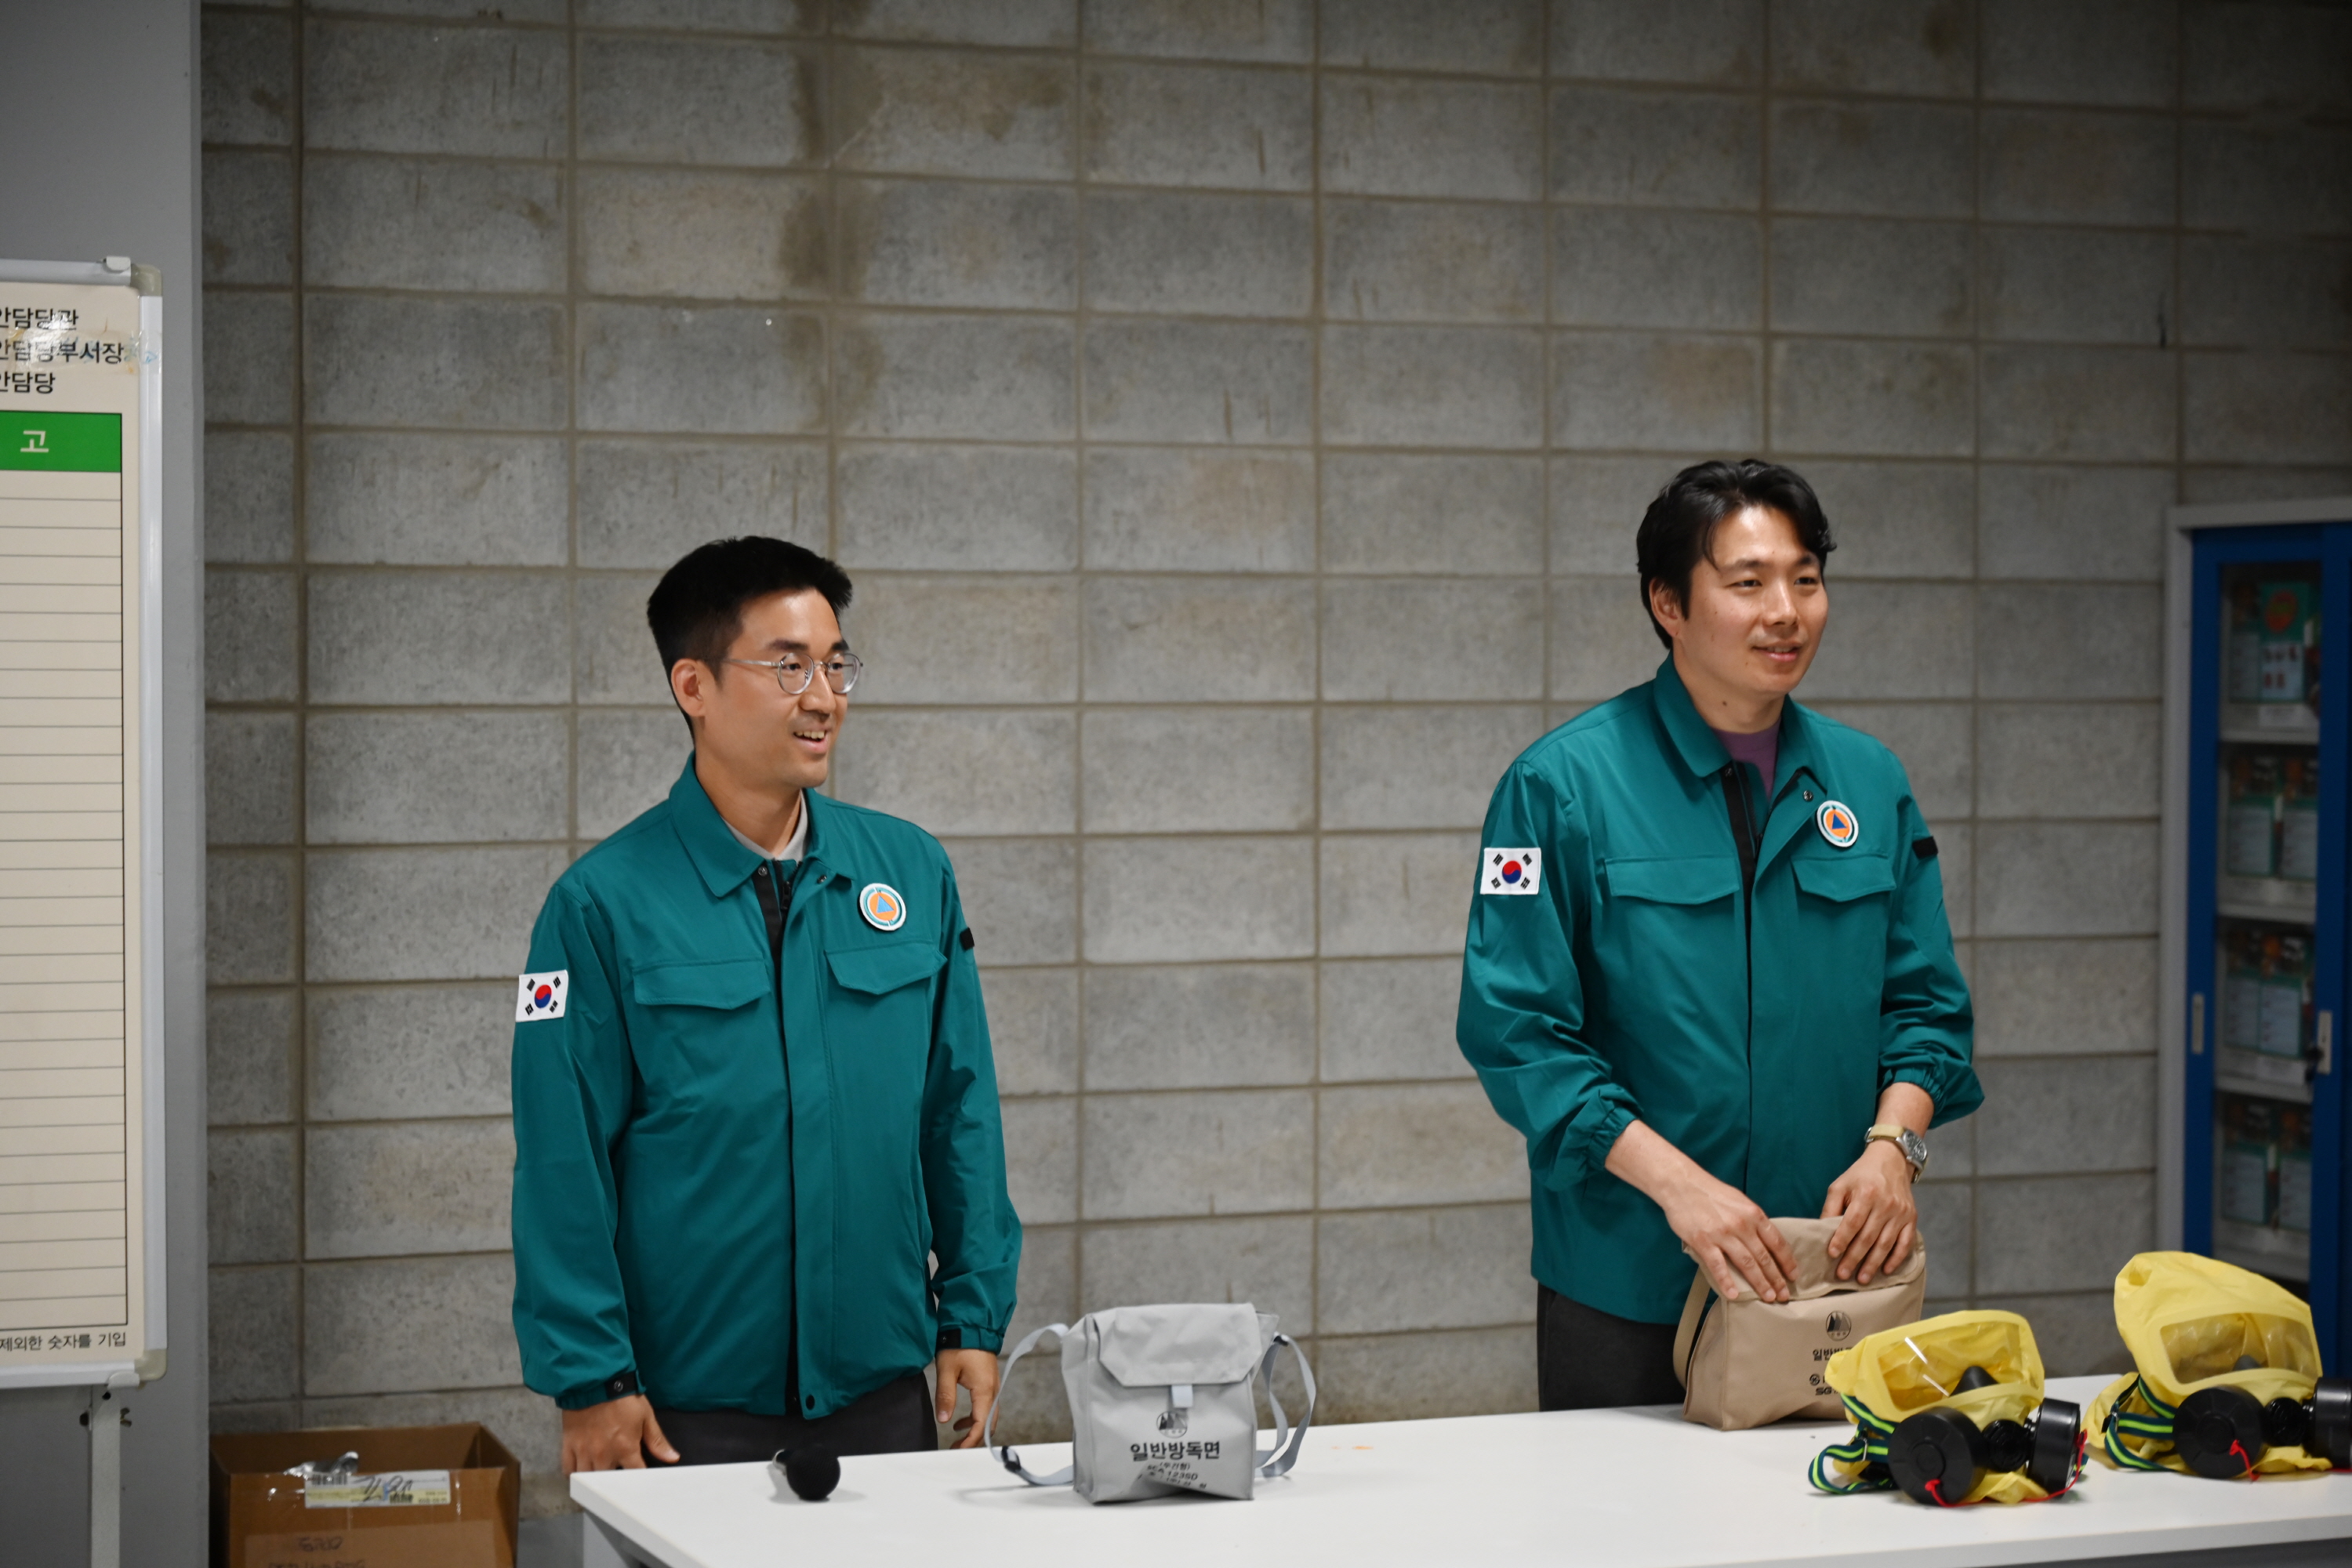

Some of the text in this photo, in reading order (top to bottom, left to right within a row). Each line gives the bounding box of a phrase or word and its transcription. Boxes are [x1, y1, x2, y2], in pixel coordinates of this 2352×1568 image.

[20, 430, 49, 453] 고
[48, 1334, 92, 1351] 숫자를
[98, 1331, 127, 1348] 기입
[1130, 1440, 1221, 1462] 일반방독면
